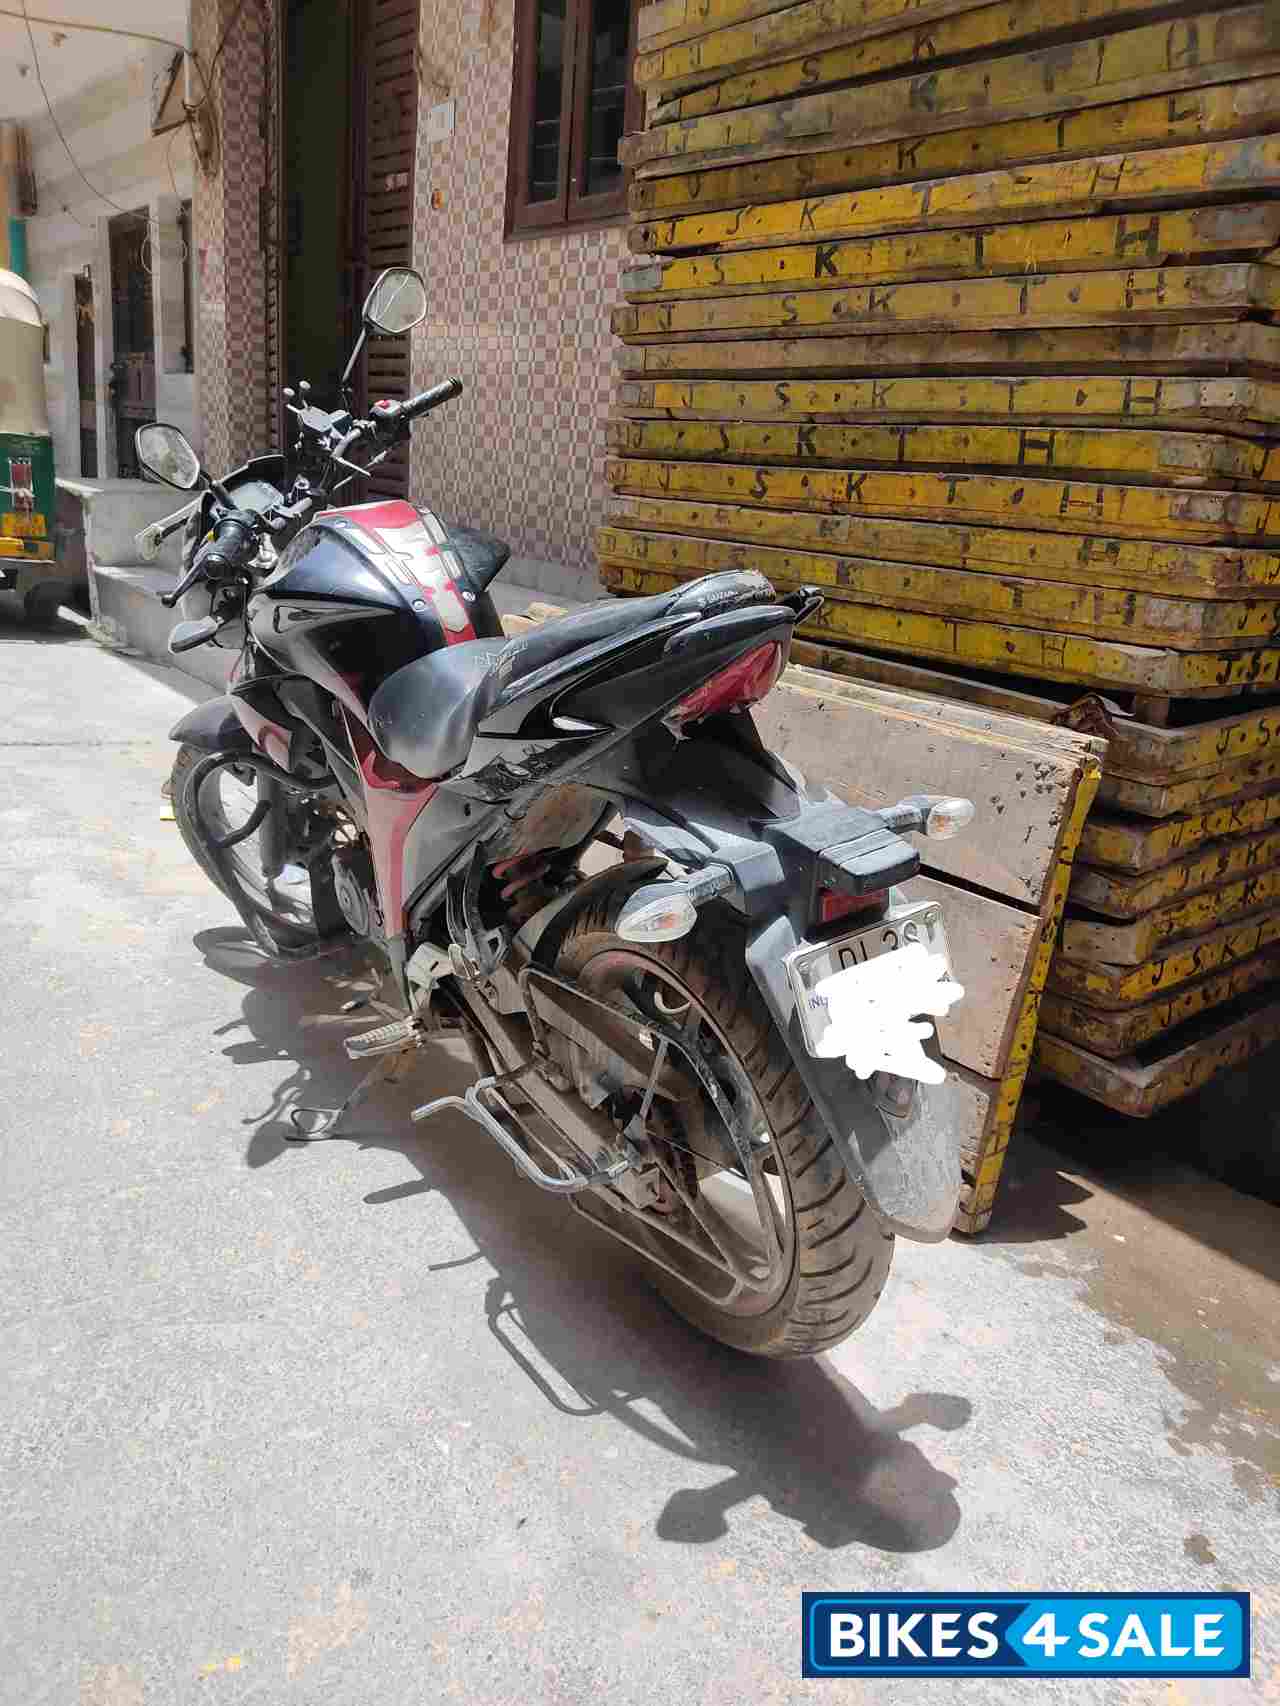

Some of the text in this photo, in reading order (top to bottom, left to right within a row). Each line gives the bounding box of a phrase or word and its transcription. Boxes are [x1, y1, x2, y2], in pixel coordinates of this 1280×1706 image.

[815, 245, 838, 278] K
[1113, 216, 1160, 258] H
[1121, 378, 1163, 417] H
[1018, 429, 1056, 466] H
[847, 472, 868, 503] K
[1216, 656, 1232, 685] J
